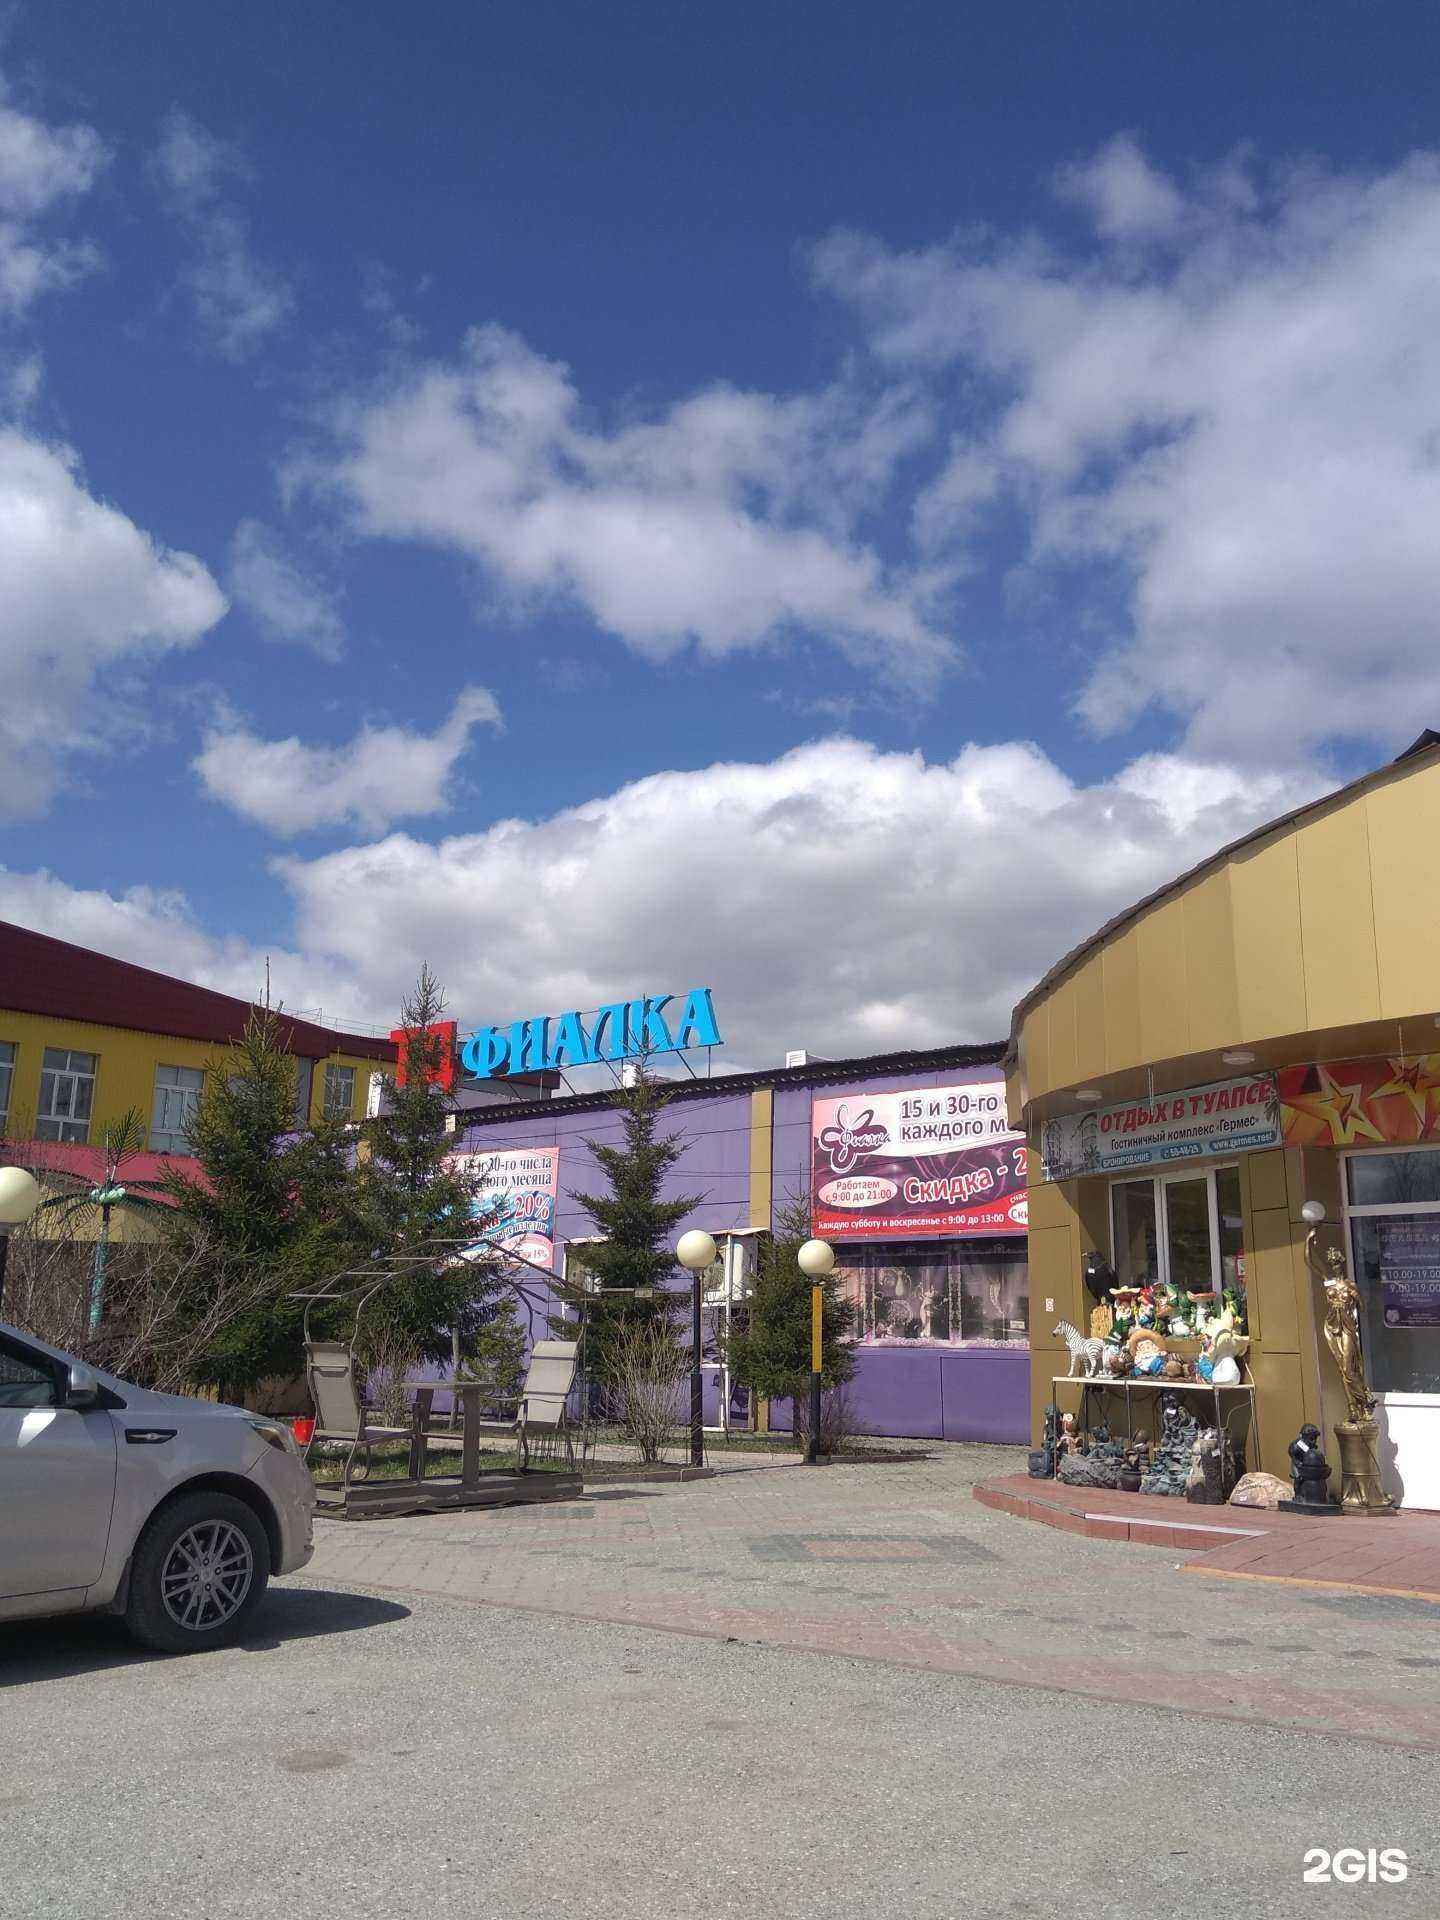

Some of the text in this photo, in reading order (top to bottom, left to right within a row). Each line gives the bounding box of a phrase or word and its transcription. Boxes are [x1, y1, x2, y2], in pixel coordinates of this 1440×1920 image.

[462, 988, 723, 1080] ФИАЛКА
[901, 1094, 999, 1119] 15 и 30-го
[1100, 1079, 1272, 1133] ОТДЫХ В ТУАПСЕ
[901, 1119, 983, 1141] каждого
[1111, 1130, 1166, 1151] Гостиничный
[1168, 1124, 1214, 1141] комплекс
[520, 1157, 552, 1169] числа
[511, 1173, 552, 1187] месяца
[836, 1181, 880, 1191] Работаем
[904, 1167, 994, 1204] Скидка
[514, 1194, 550, 1219] 20%
[832, 1191, 851, 1201] 9:00
[853, 1193, 865, 1202] до
[867, 1189, 892, 1200] 21:00
[851, 1219, 880, 1230] субботу
[889, 1218, 939, 1229] воскресенье
[948, 1215, 966, 1225] 9:00
[968, 1216, 979, 1226] до
[981, 1213, 1005, 1224] 13:00
